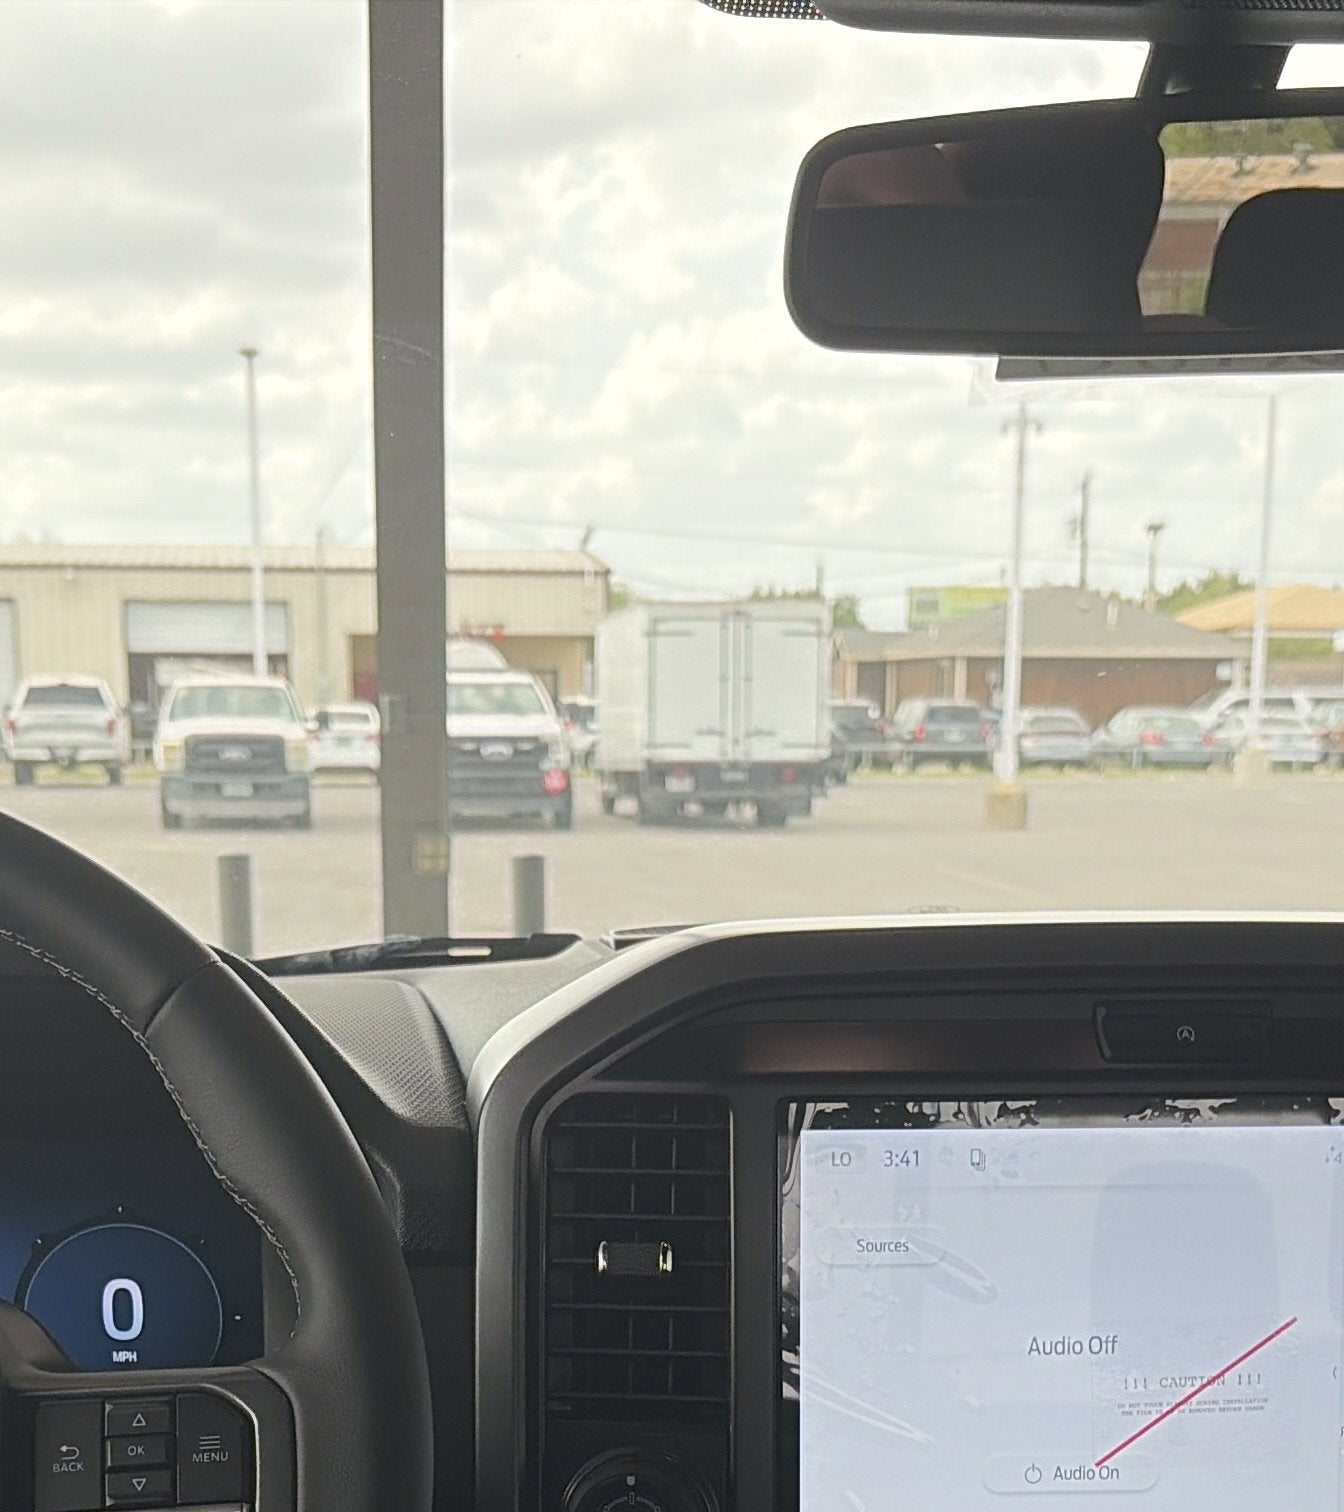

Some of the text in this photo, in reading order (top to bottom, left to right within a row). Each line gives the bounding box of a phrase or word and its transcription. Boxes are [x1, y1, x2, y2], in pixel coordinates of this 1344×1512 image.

[831, 1151, 851, 1167] LO
[883, 1150, 919, 1167] 3:41
[857, 1238, 909, 1253] Sources
[102, 1278, 144, 1341] 0
[1027, 1334, 1118, 1356] Audio Off
[112, 1350, 137, 1362] MPH
[1159, 1375, 1226, 1388] CAUTION
[127, 1445, 145, 1456] OK
[192, 1451, 229, 1463] MENU
[52, 1463, 84, 1473] BACK
[1053, 1465, 1120, 1481] Audio On
